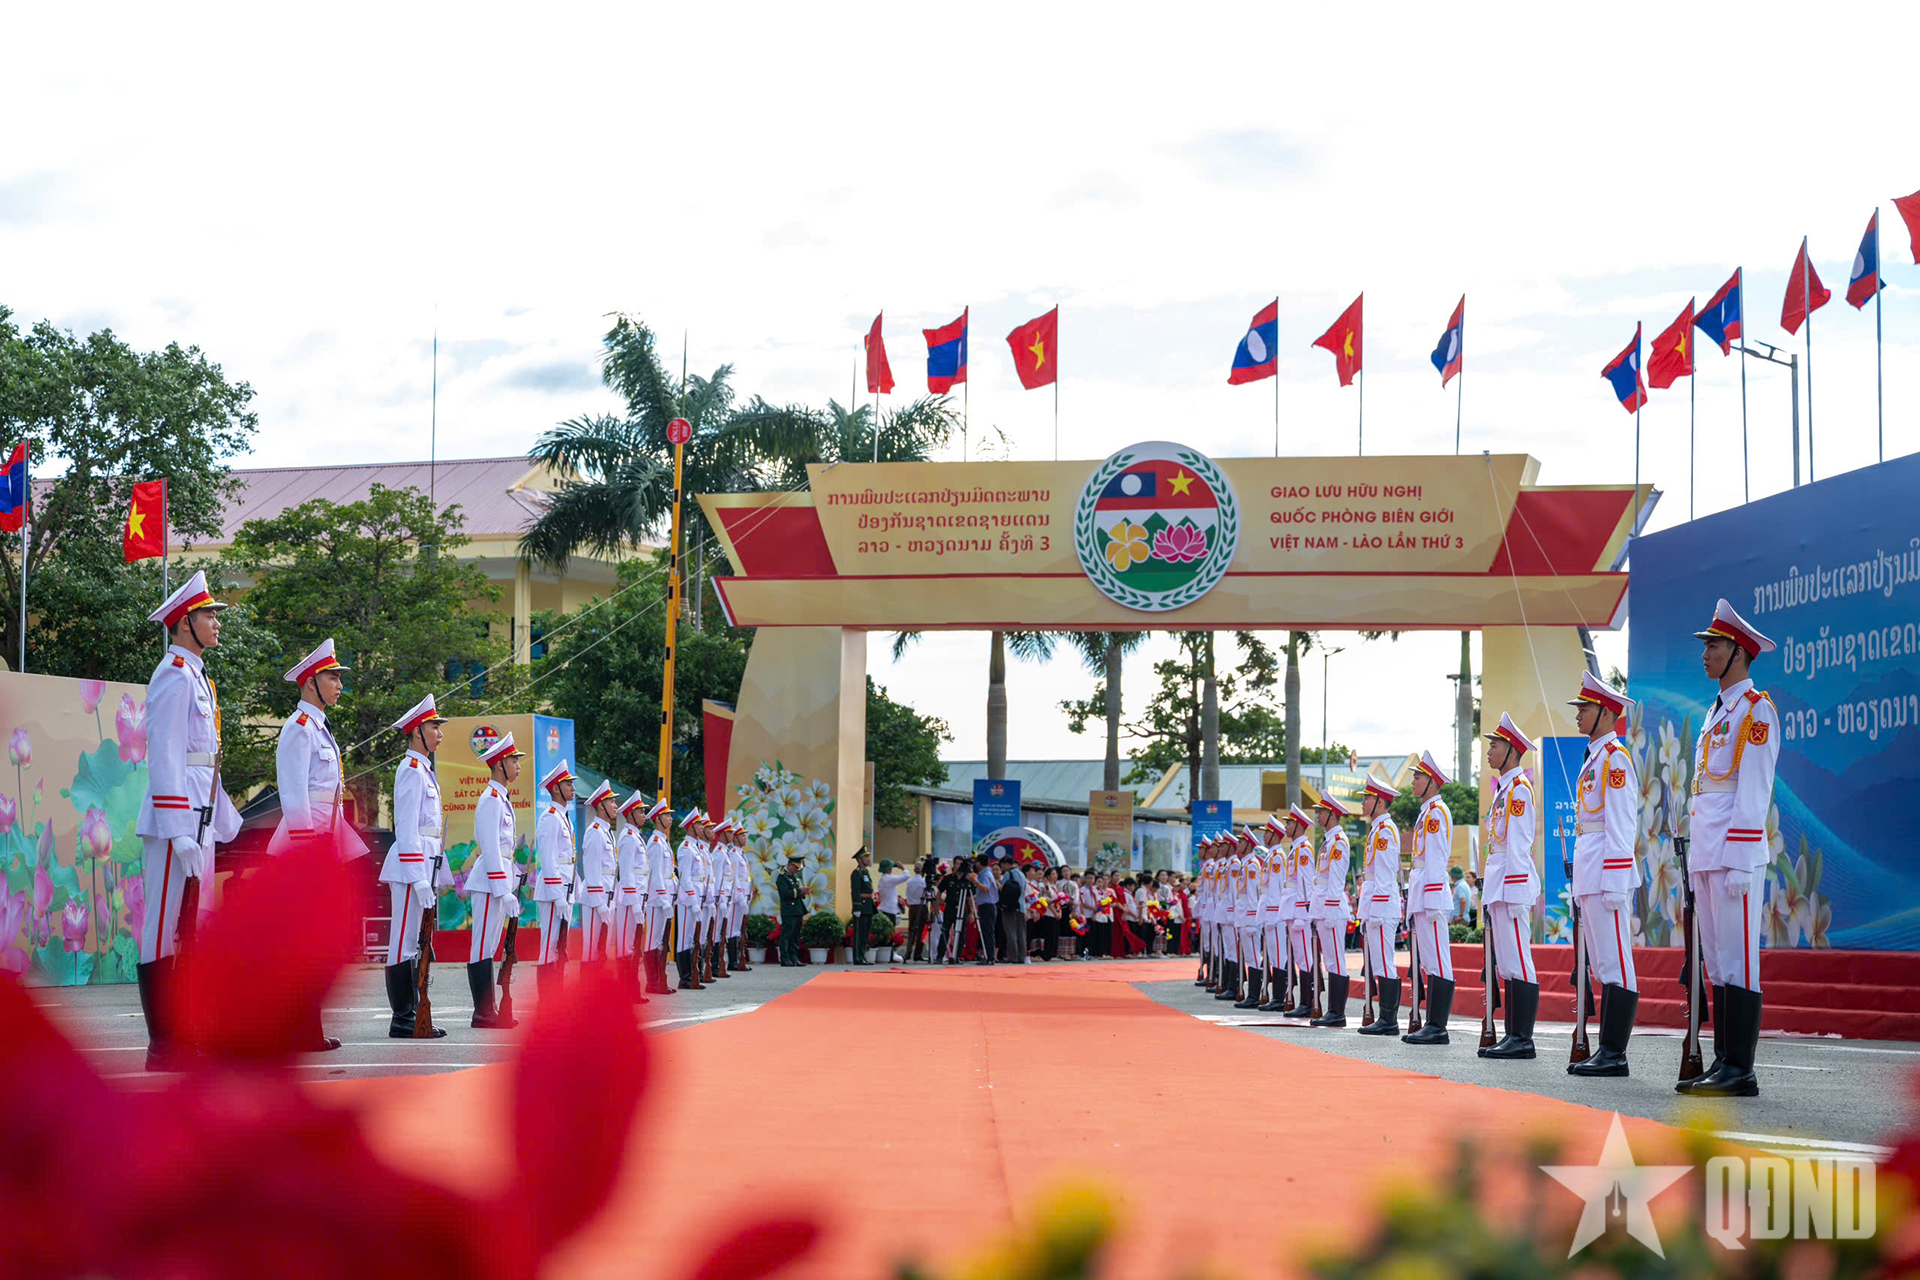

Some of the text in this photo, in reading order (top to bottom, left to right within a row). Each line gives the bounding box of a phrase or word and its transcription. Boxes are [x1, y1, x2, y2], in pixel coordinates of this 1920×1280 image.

[1270, 482, 1422, 501] GIAO LƯU HỮU NGHỊ
[1270, 506, 1454, 524] QUỐC PHÒNG BIÊN GIỚI
[858, 541, 889, 552] ລາວ
[1040, 536, 1050, 550] 3
[1270, 534, 1300, 552] VIỆT
[1304, 536, 1338, 548] NAM
[1352, 533, 1382, 548] LÀO
[1388, 531, 1416, 548] LẦN
[1422, 534, 1450, 548] THỨ
[1455, 536, 1464, 548] 3
[1784, 623, 1920, 680] ປ້ອງກັນຊາດເຂດ
[1785, 708, 1818, 740] ລາວ
[459, 776, 474, 786] VIỆT
